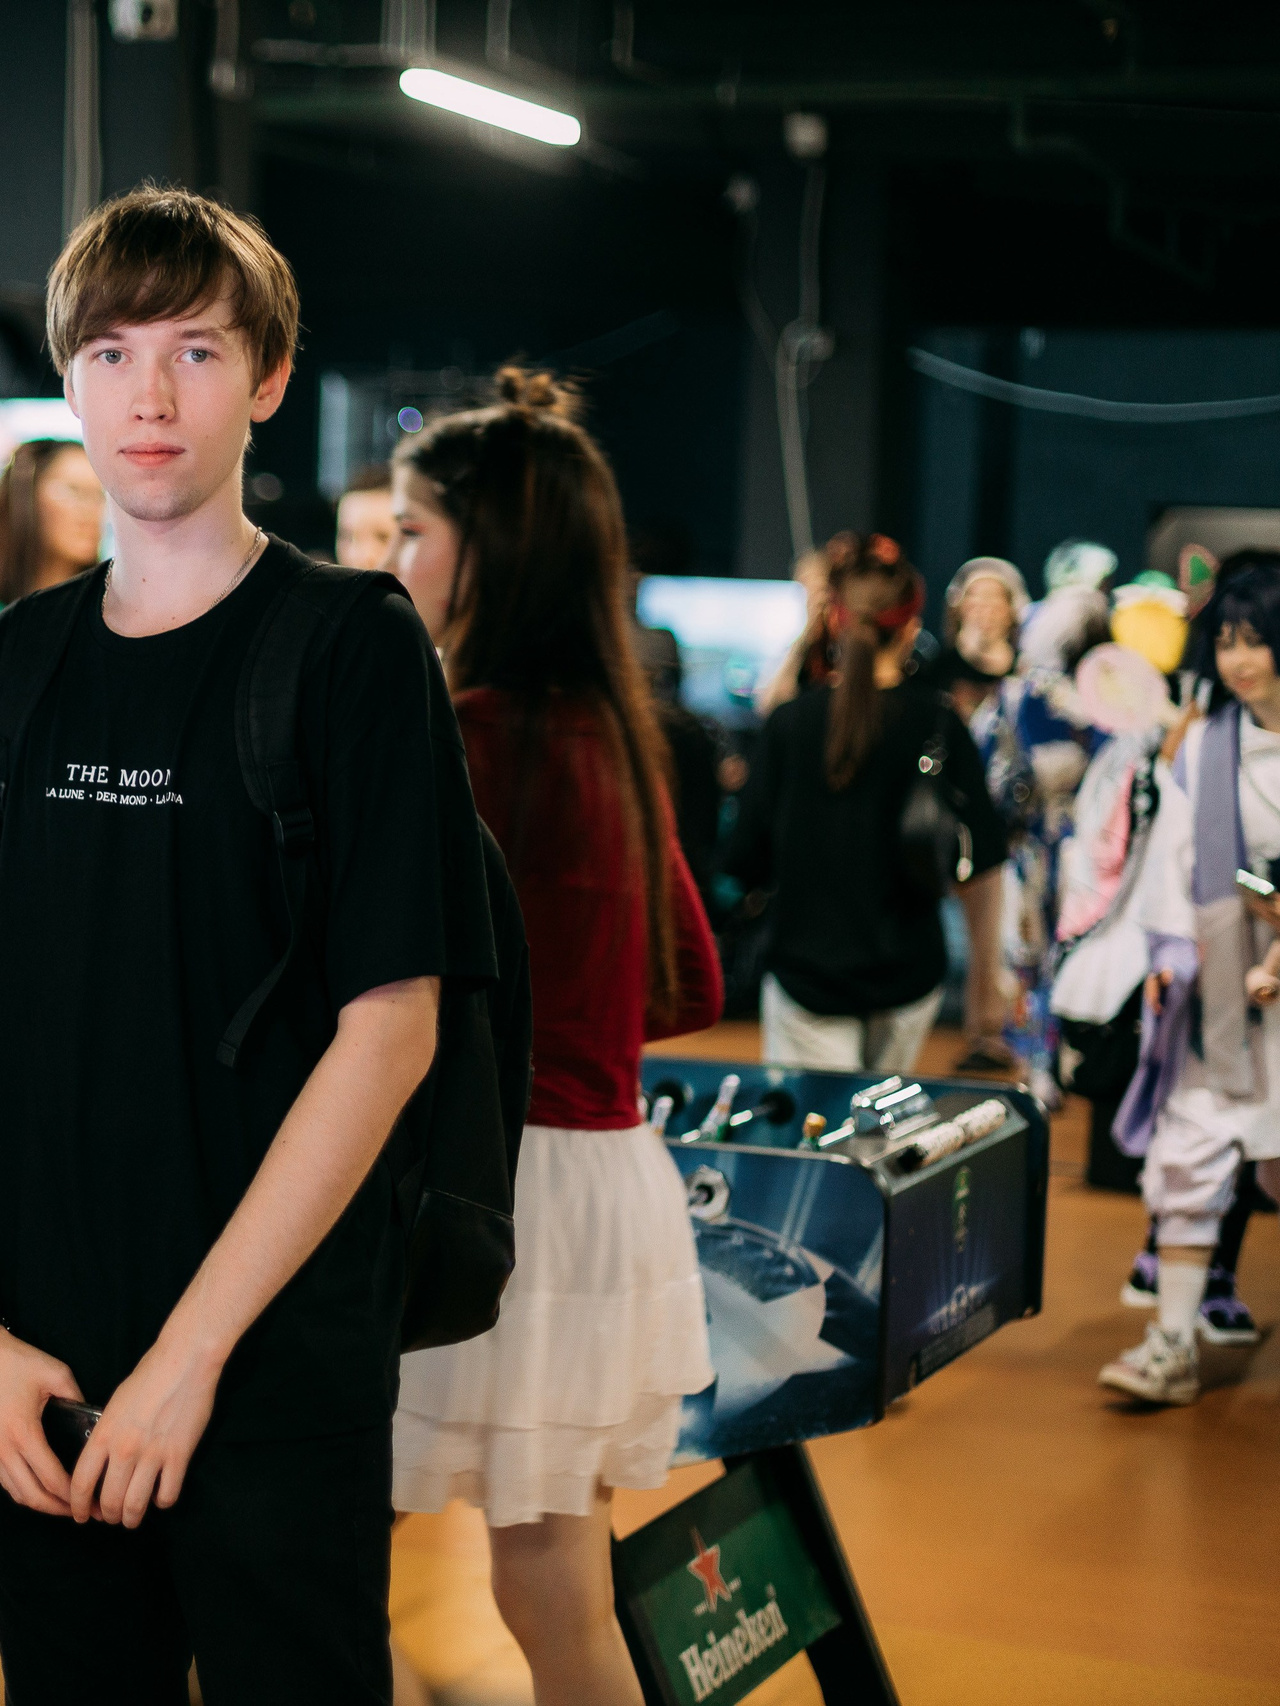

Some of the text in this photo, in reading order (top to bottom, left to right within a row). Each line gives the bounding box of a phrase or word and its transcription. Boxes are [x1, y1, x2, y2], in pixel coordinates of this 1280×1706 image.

[67, 764, 109, 783] THE
[45, 787, 57, 798] LA
[58, 788, 85, 800] LUNE
[96, 791, 117, 803] DER
[119, 794, 147, 806] MOND
[678, 1582, 789, 1703] Heineken
